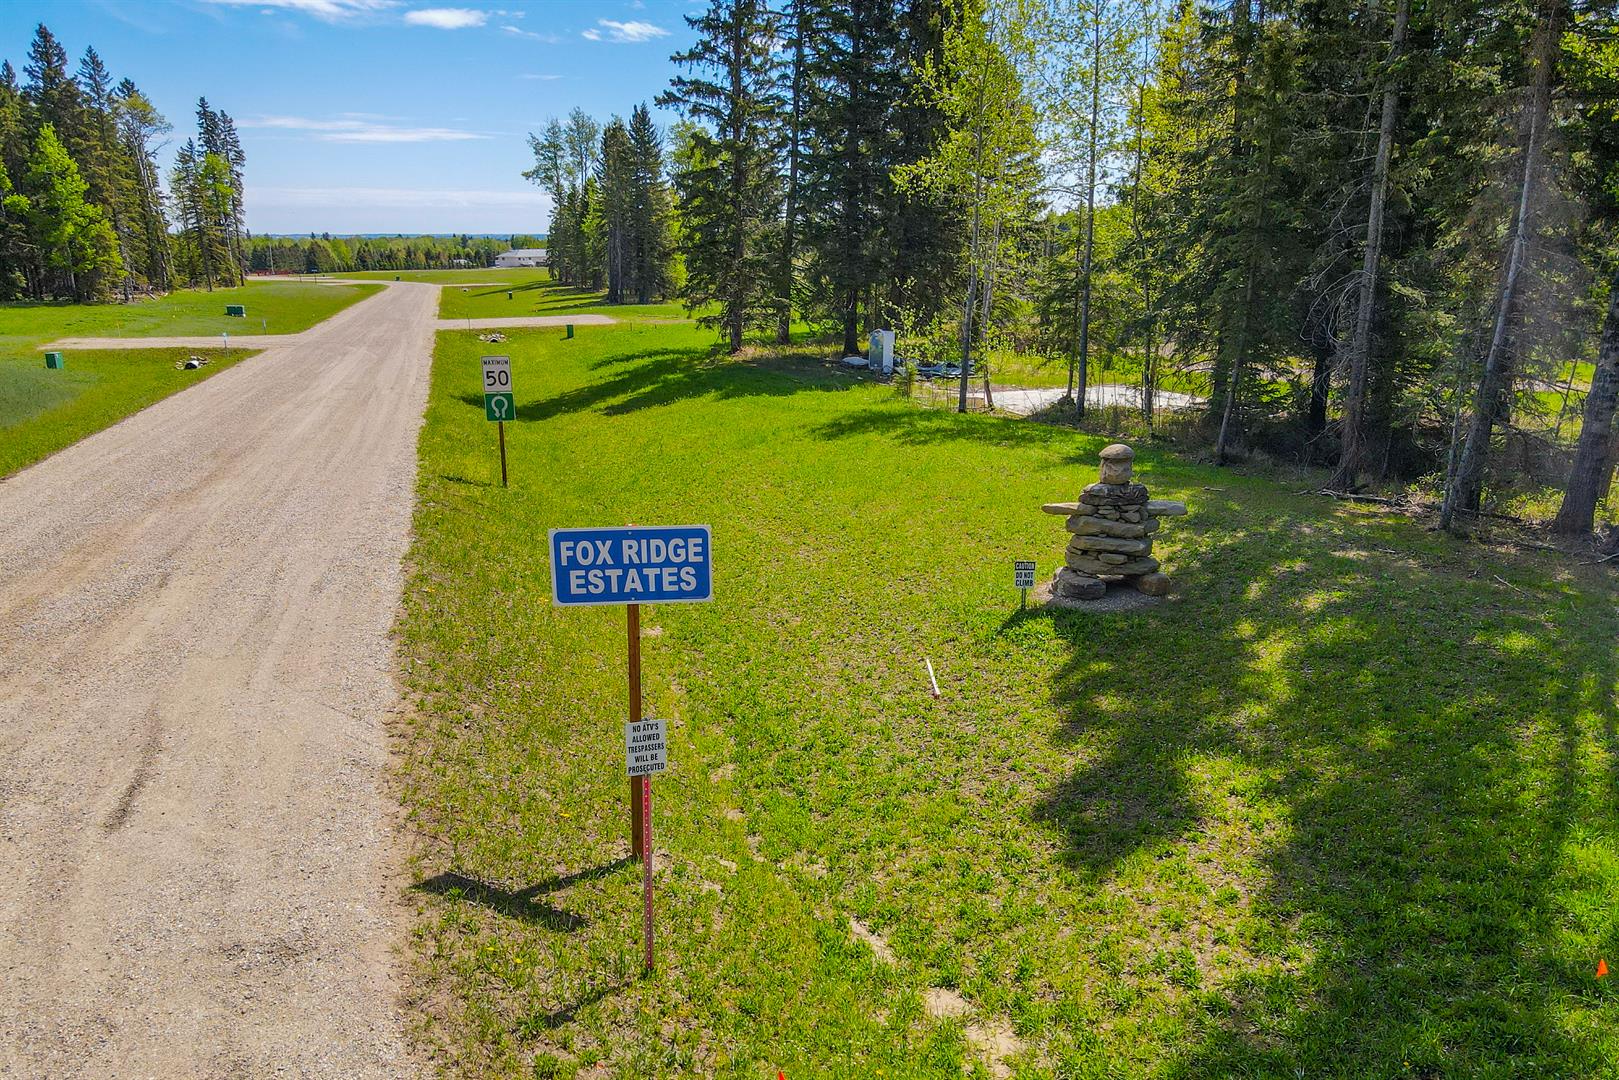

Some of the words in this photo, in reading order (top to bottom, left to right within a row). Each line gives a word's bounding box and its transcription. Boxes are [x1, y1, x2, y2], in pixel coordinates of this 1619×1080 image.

[486, 370, 509, 386] 50
[560, 540, 614, 566] FOX
[622, 537, 704, 564] RIDGE
[569, 566, 697, 595] ESTATES
[1015, 579, 1034, 587] CLIMB
[632, 725, 641, 733] NO
[643, 722, 659, 731] ATV'S
[632, 733, 660, 743] ALLOWED
[628, 743, 665, 754] TRESPASSERS
[635, 754, 649, 763] WILL
[650, 753, 658, 761] BE
[628, 762, 665, 774] PROSECUTED
